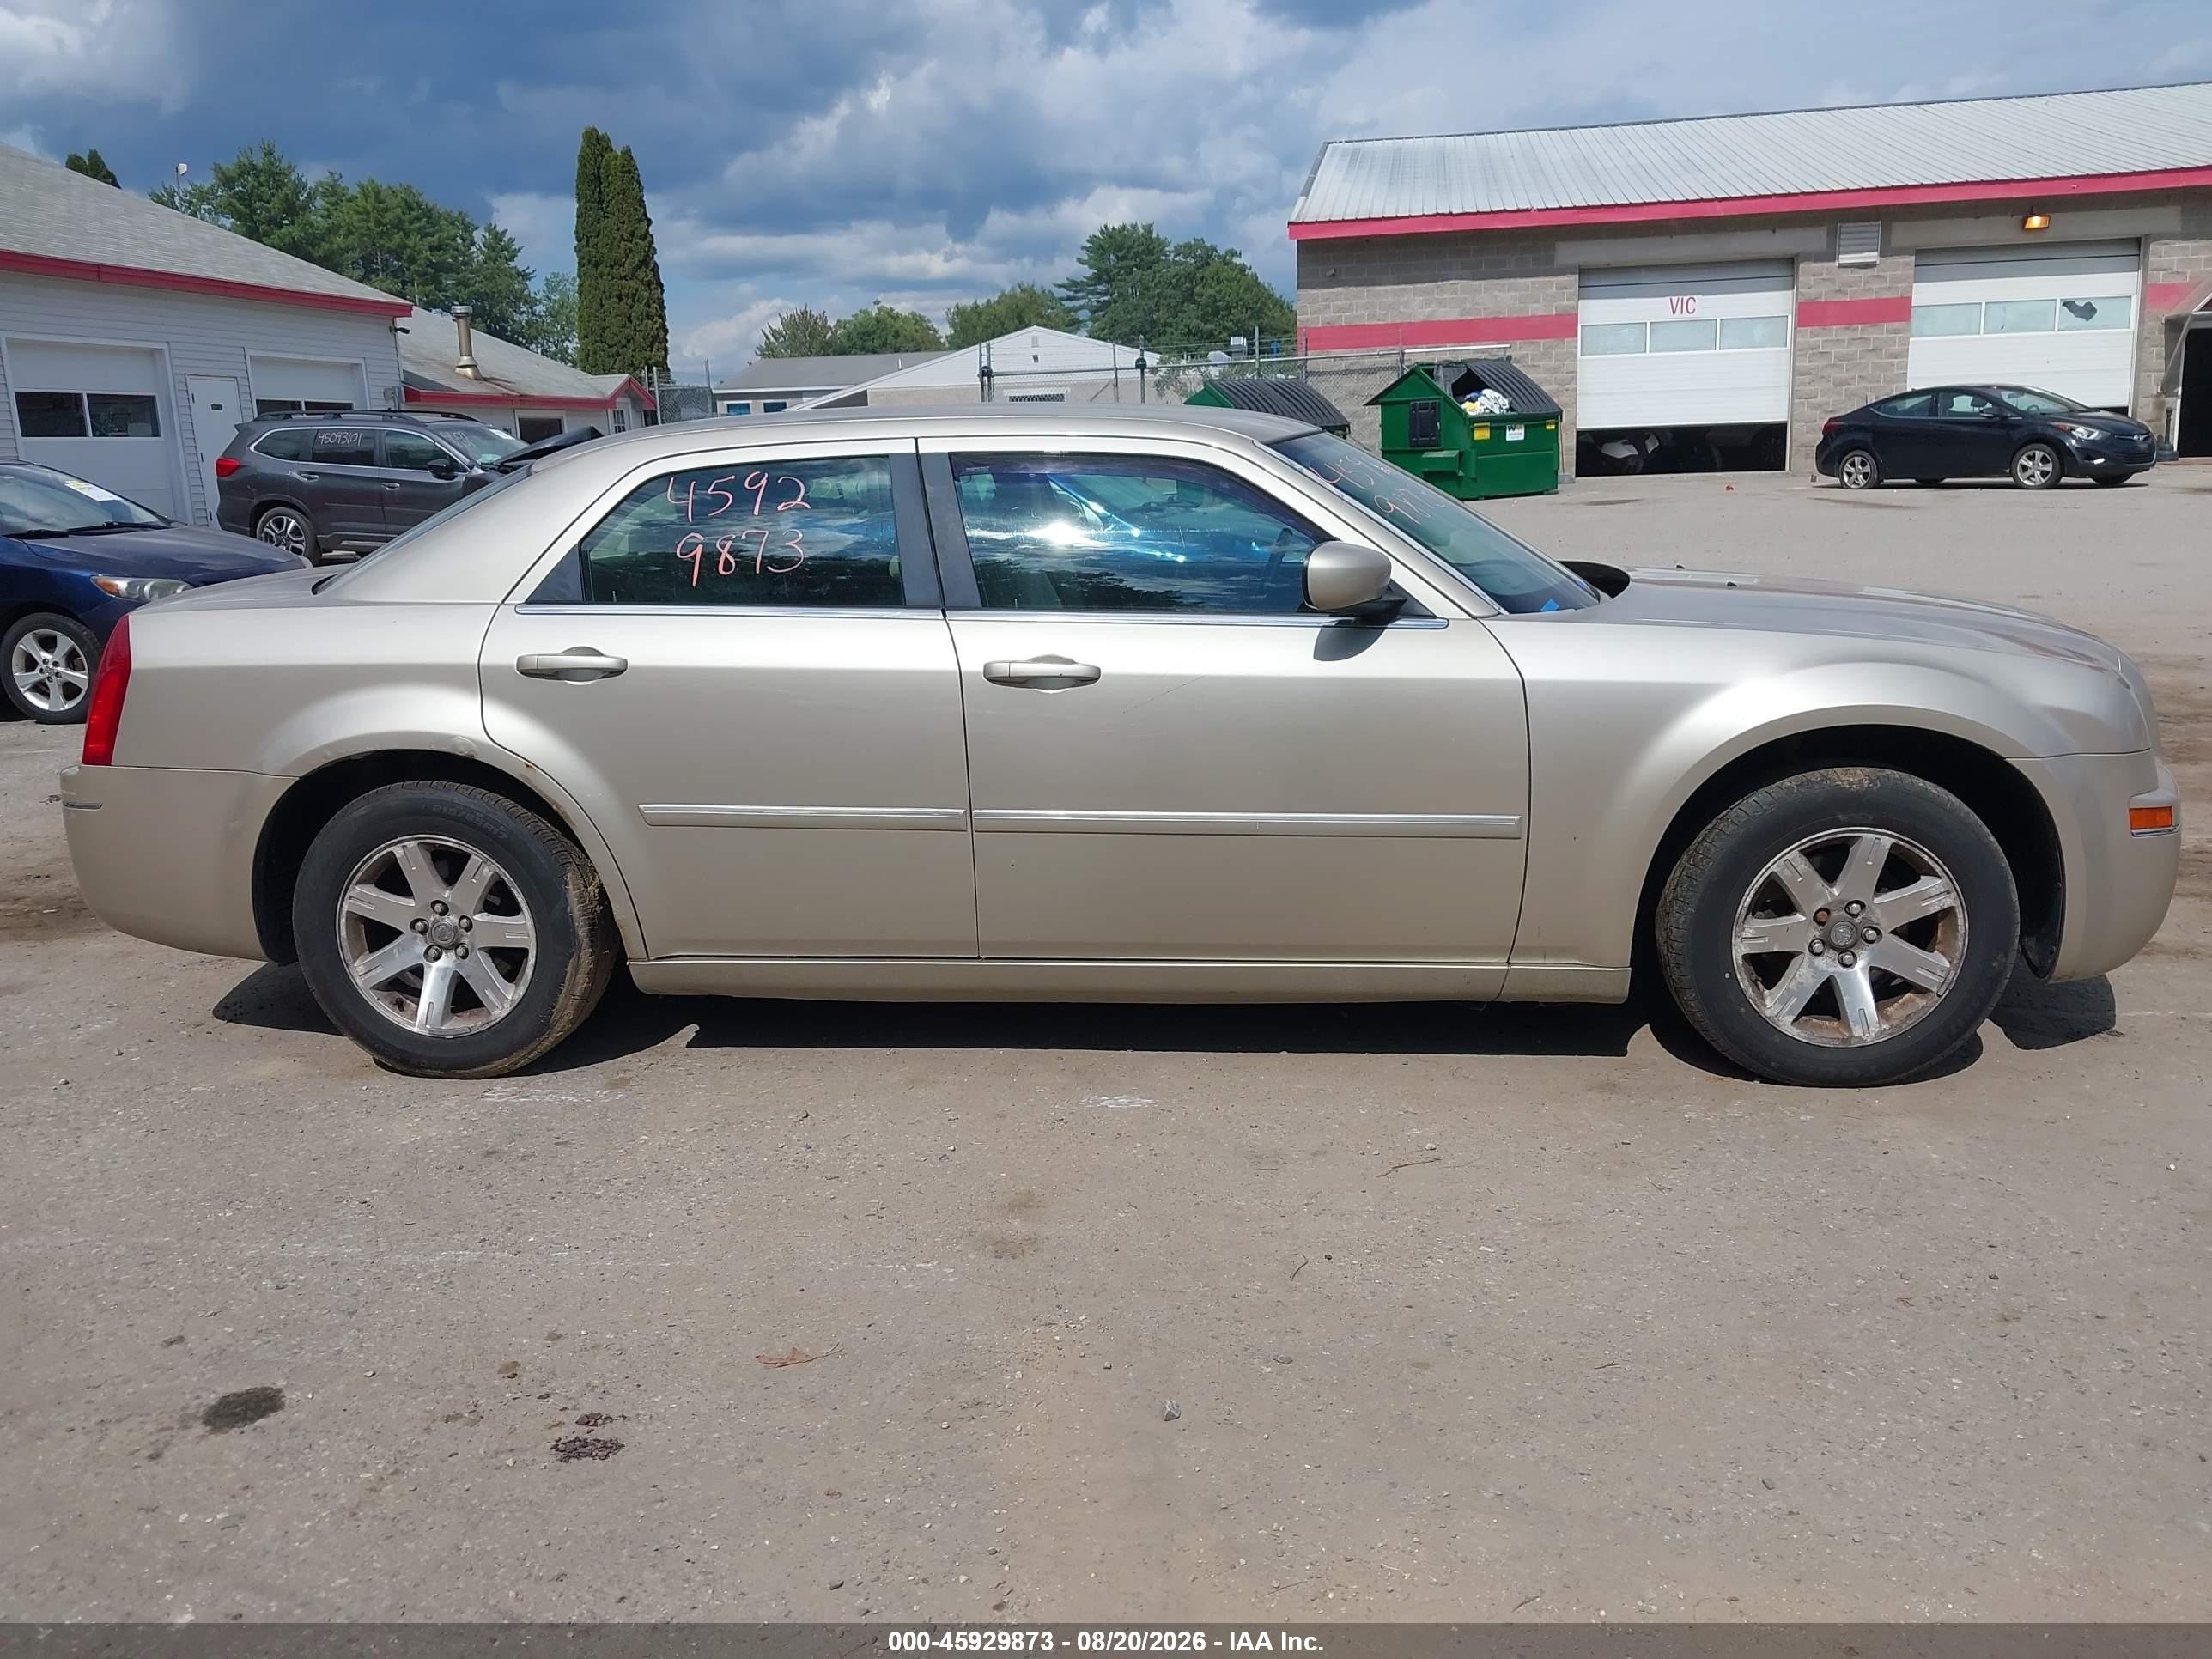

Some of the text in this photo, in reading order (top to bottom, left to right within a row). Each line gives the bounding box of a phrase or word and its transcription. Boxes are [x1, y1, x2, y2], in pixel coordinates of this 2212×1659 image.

[1669, 296, 1697, 315] VIC
[318, 431, 363, 447] 45093101
[1308, 453, 1390, 490] 459
[666, 471, 811, 522] 4592
[676, 528, 805, 587] 9873
